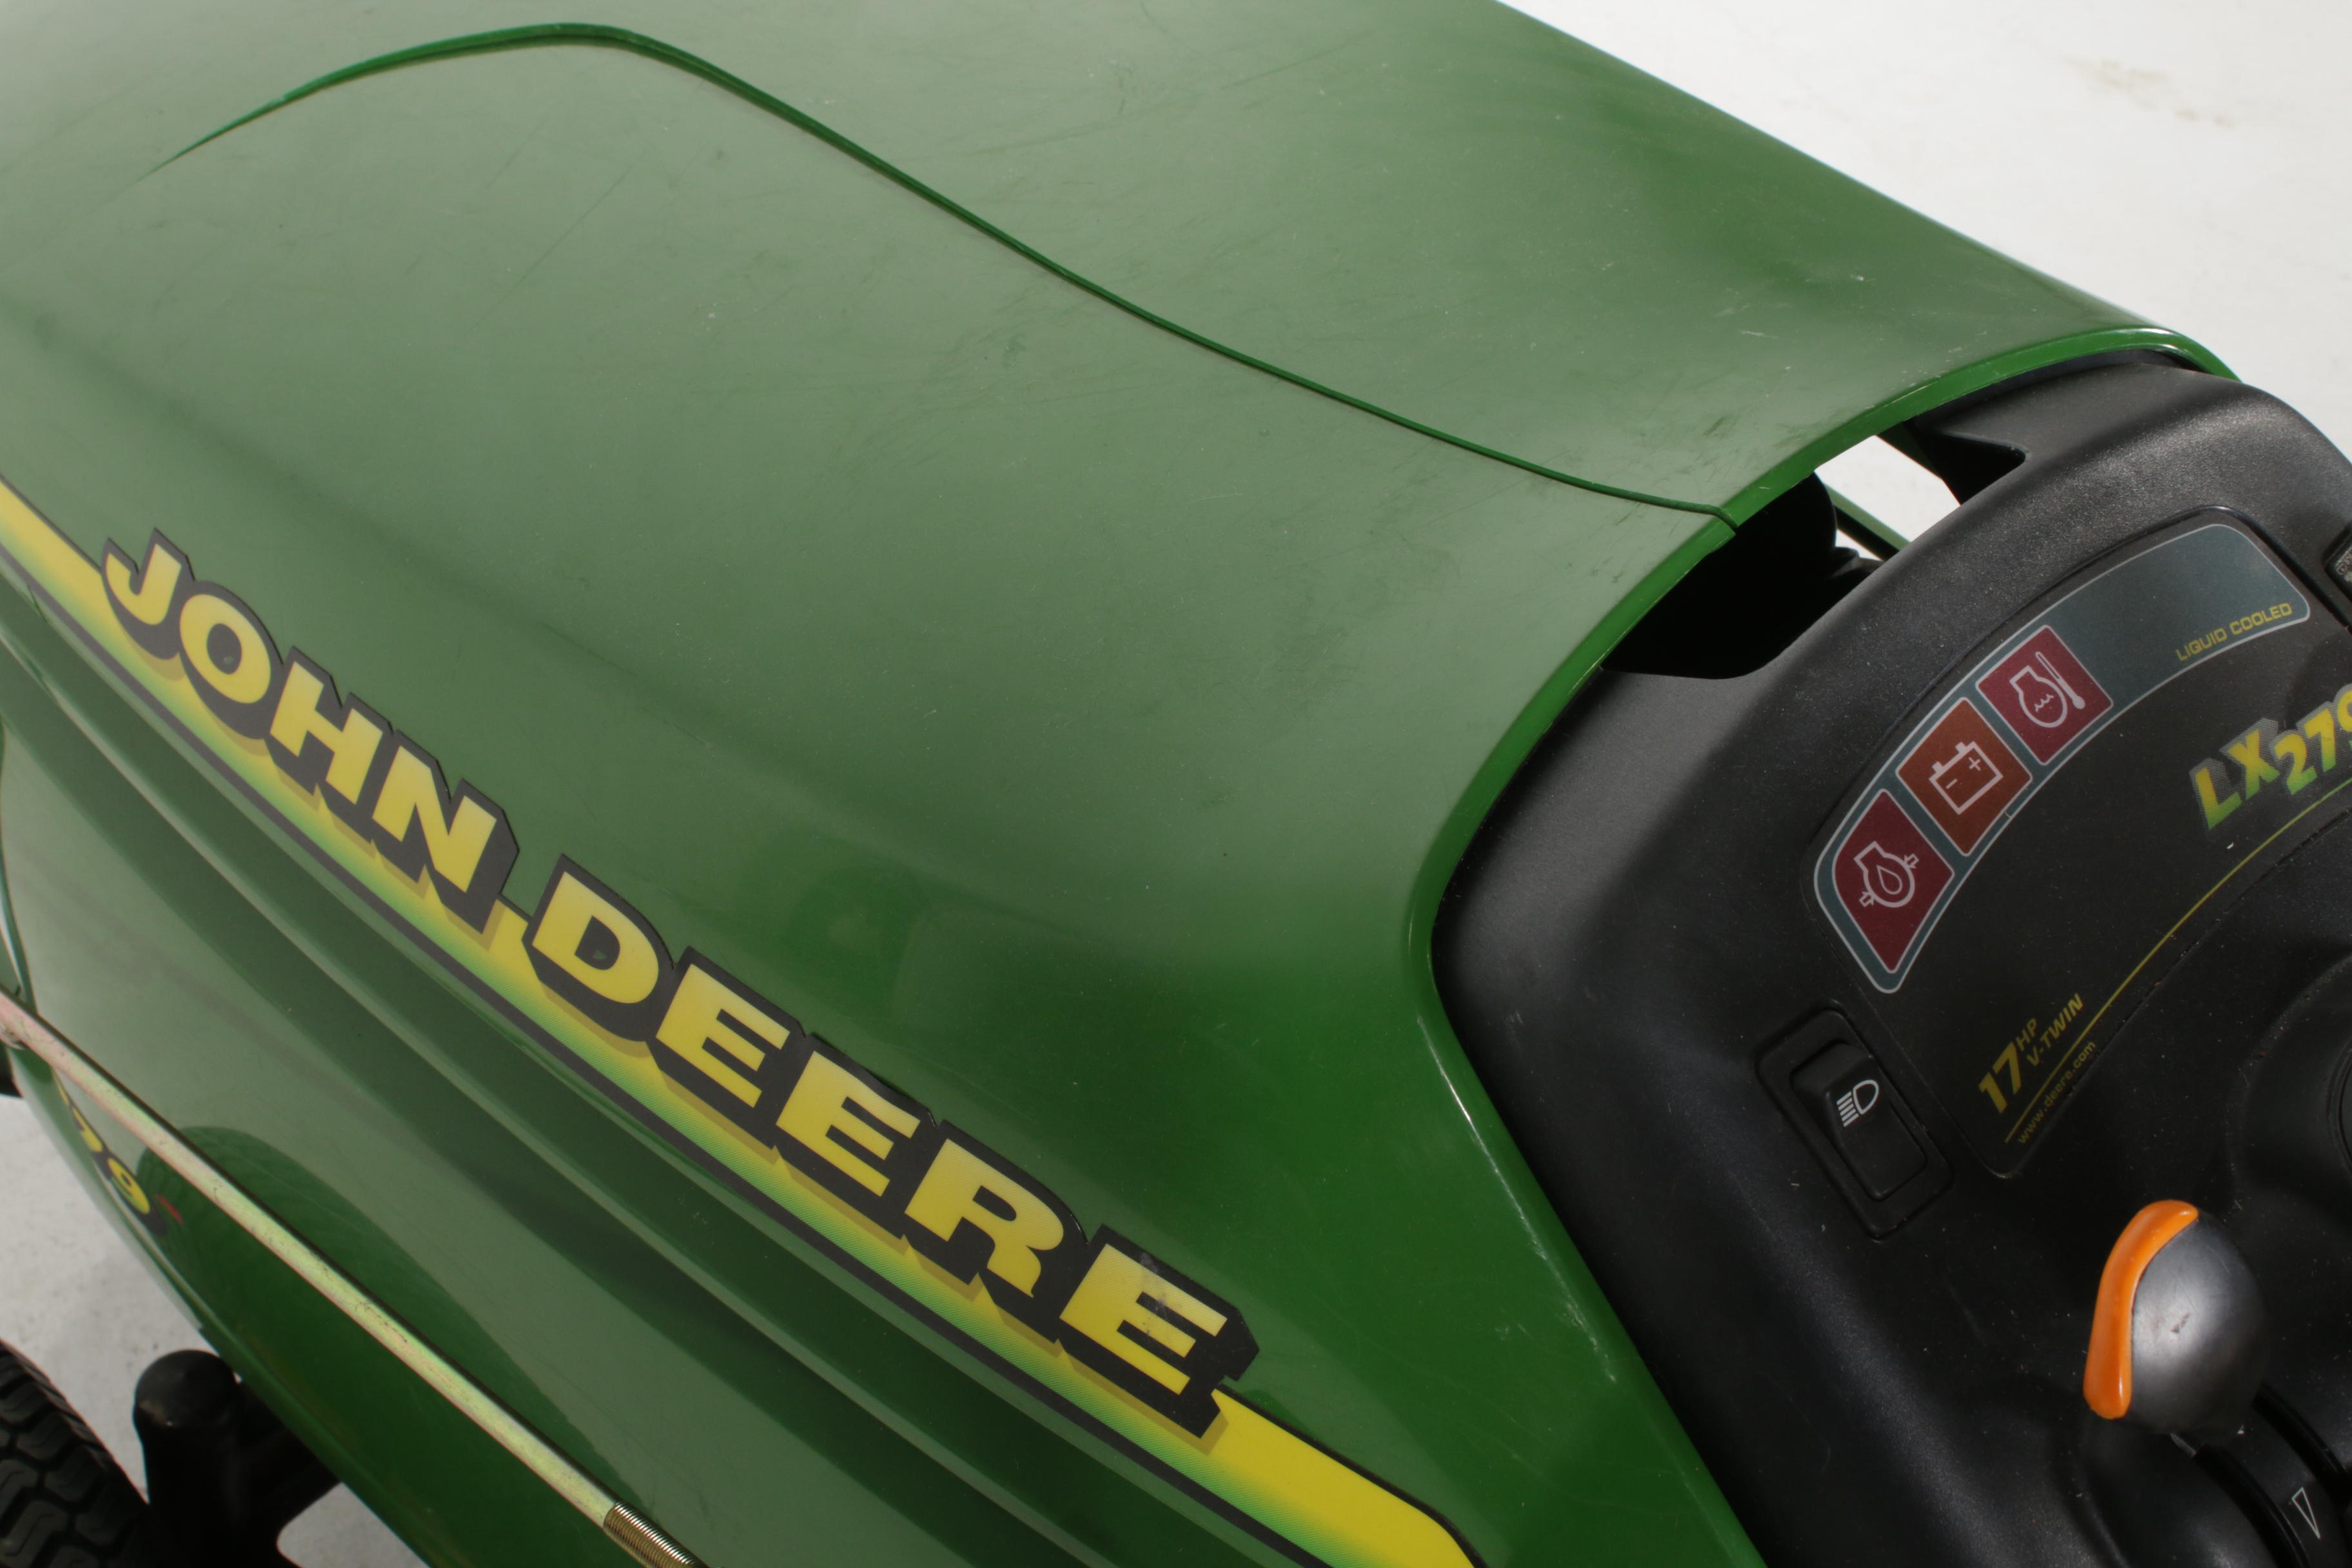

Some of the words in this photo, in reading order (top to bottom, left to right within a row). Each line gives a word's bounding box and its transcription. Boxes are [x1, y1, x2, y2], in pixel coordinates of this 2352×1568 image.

[2176, 628, 2228, 662] LIQUID
[2230, 603, 2293, 635] COOLED
[104, 542, 498, 894] JOHN
[531, 870, 1229, 1396] DEERE
[1979, 1041, 2021, 1113] 17
[2016, 1018, 2037, 1052] HP
[2027, 993, 2083, 1066] V-TWIN
[2019, 1041, 2095, 1144] www.deere.com
